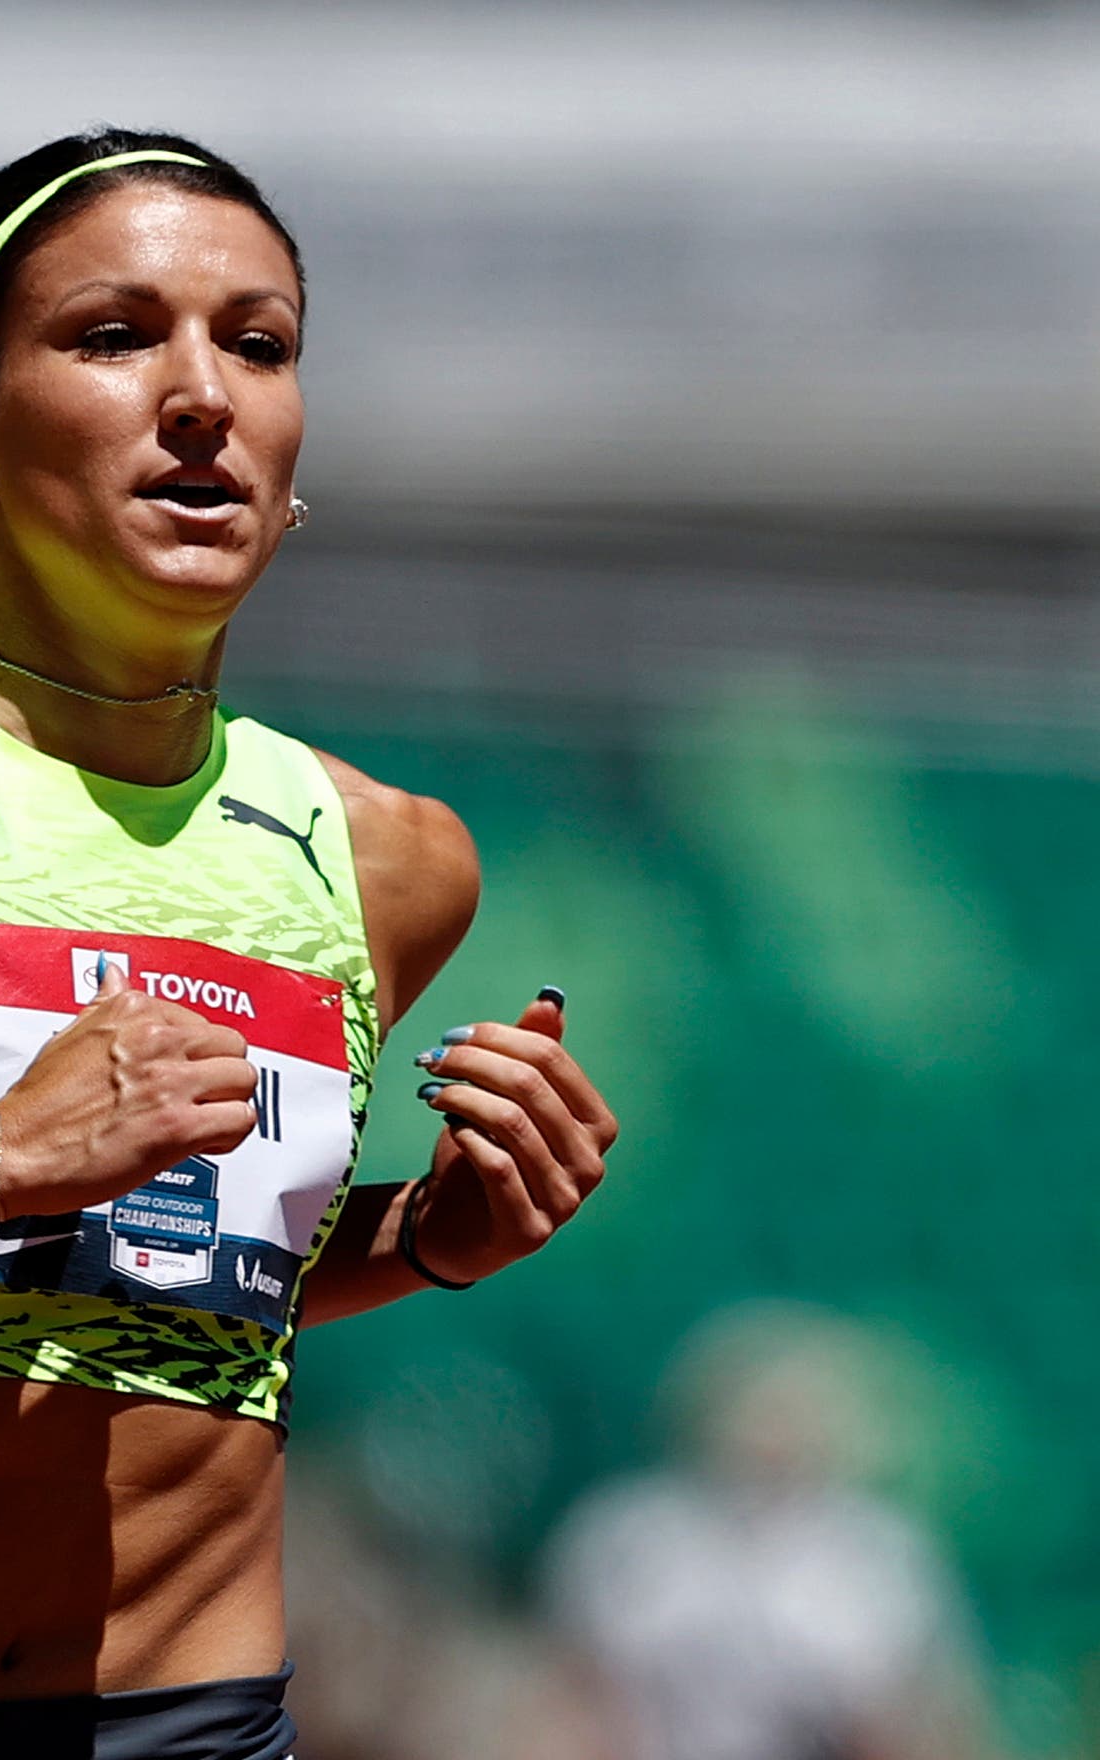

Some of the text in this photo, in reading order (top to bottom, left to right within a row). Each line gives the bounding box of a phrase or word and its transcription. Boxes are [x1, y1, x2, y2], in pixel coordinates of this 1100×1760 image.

[139, 970, 256, 1019] TOYOTA
[126, 1193, 204, 1215] 2022 OUTDOOR
[114, 1207, 212, 1237] CHAMPIONSHIPS
[257, 1272, 284, 1299] USATF
